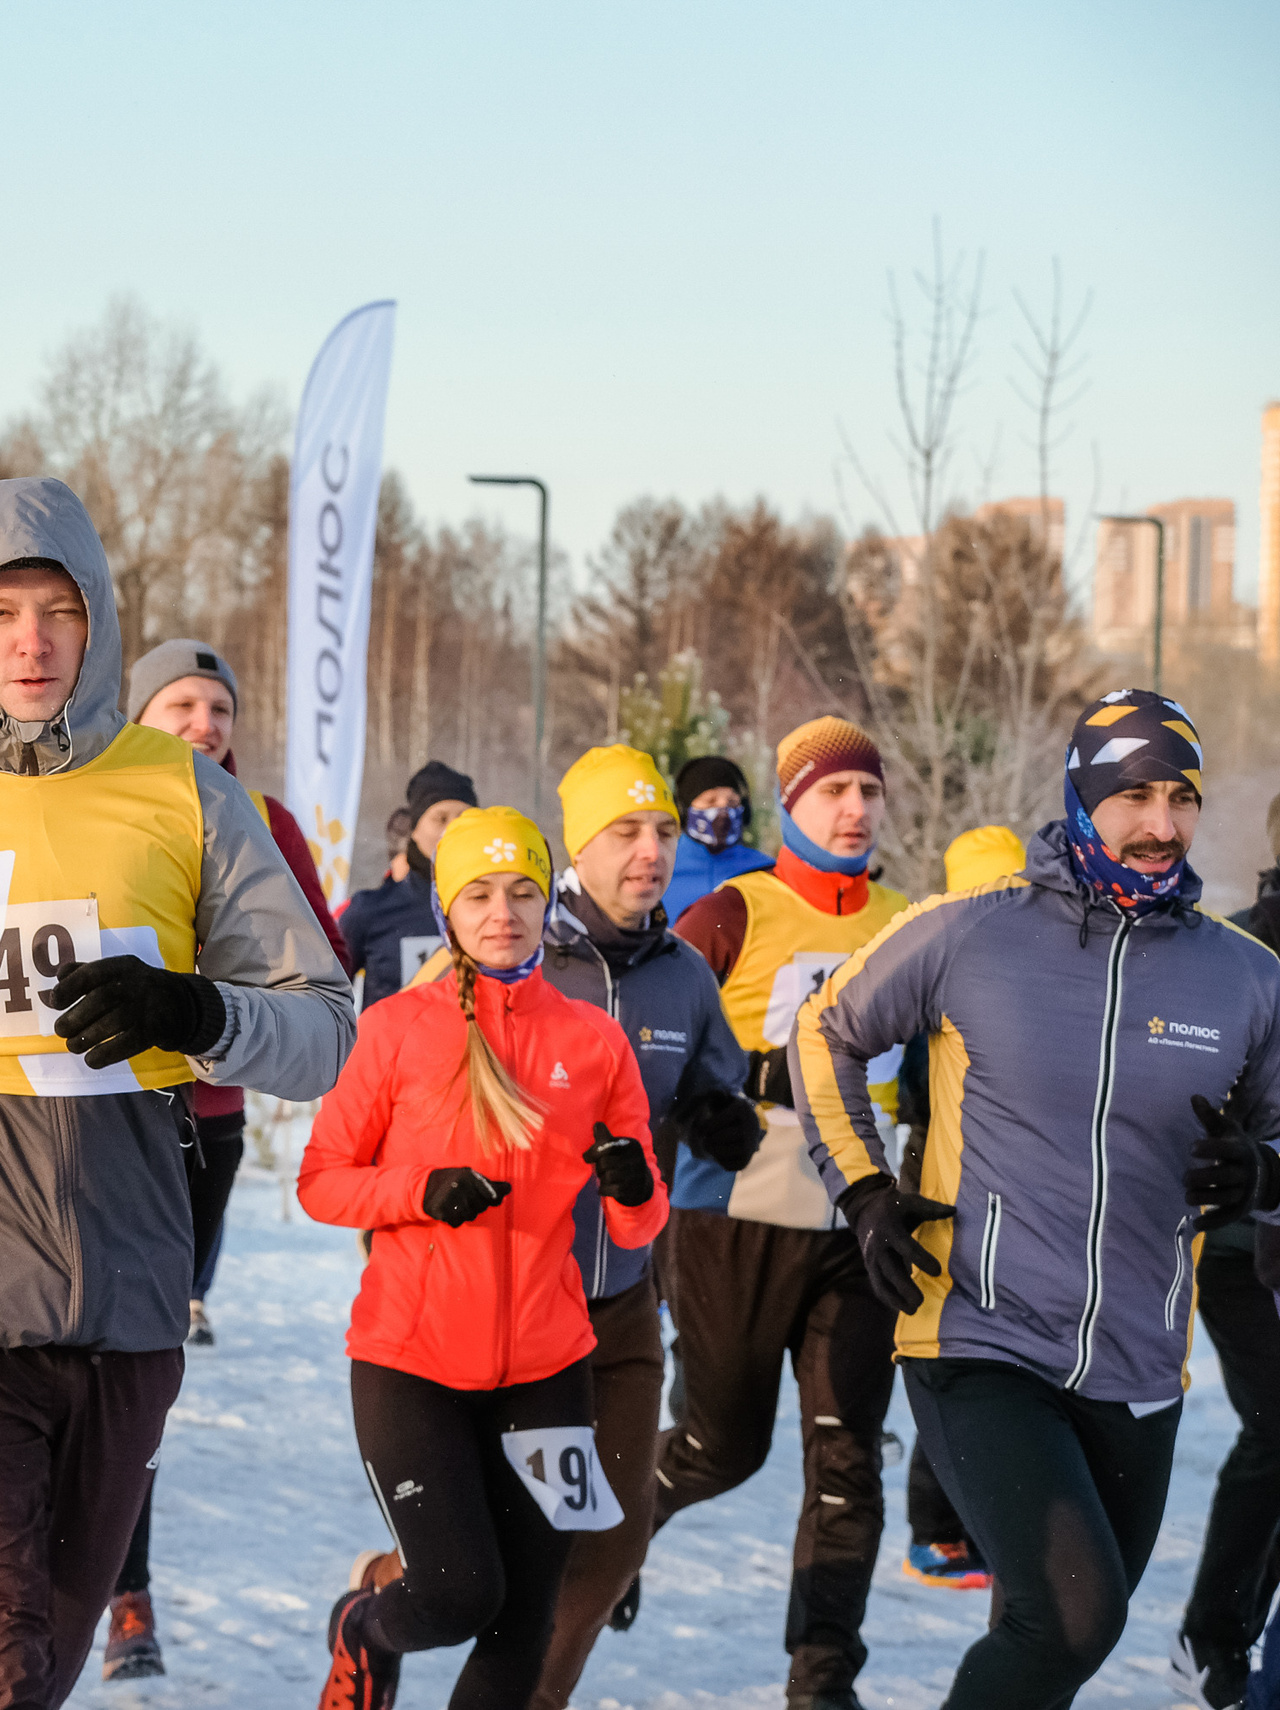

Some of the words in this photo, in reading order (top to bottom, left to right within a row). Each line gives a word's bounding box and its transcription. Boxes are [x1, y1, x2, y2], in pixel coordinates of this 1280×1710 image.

[315, 442, 350, 767] ПОЛЮС
[527, 848, 550, 879] ПО
[1169, 1022, 1221, 1040] ПОЛЮС
[526, 1446, 598, 1513] 19
